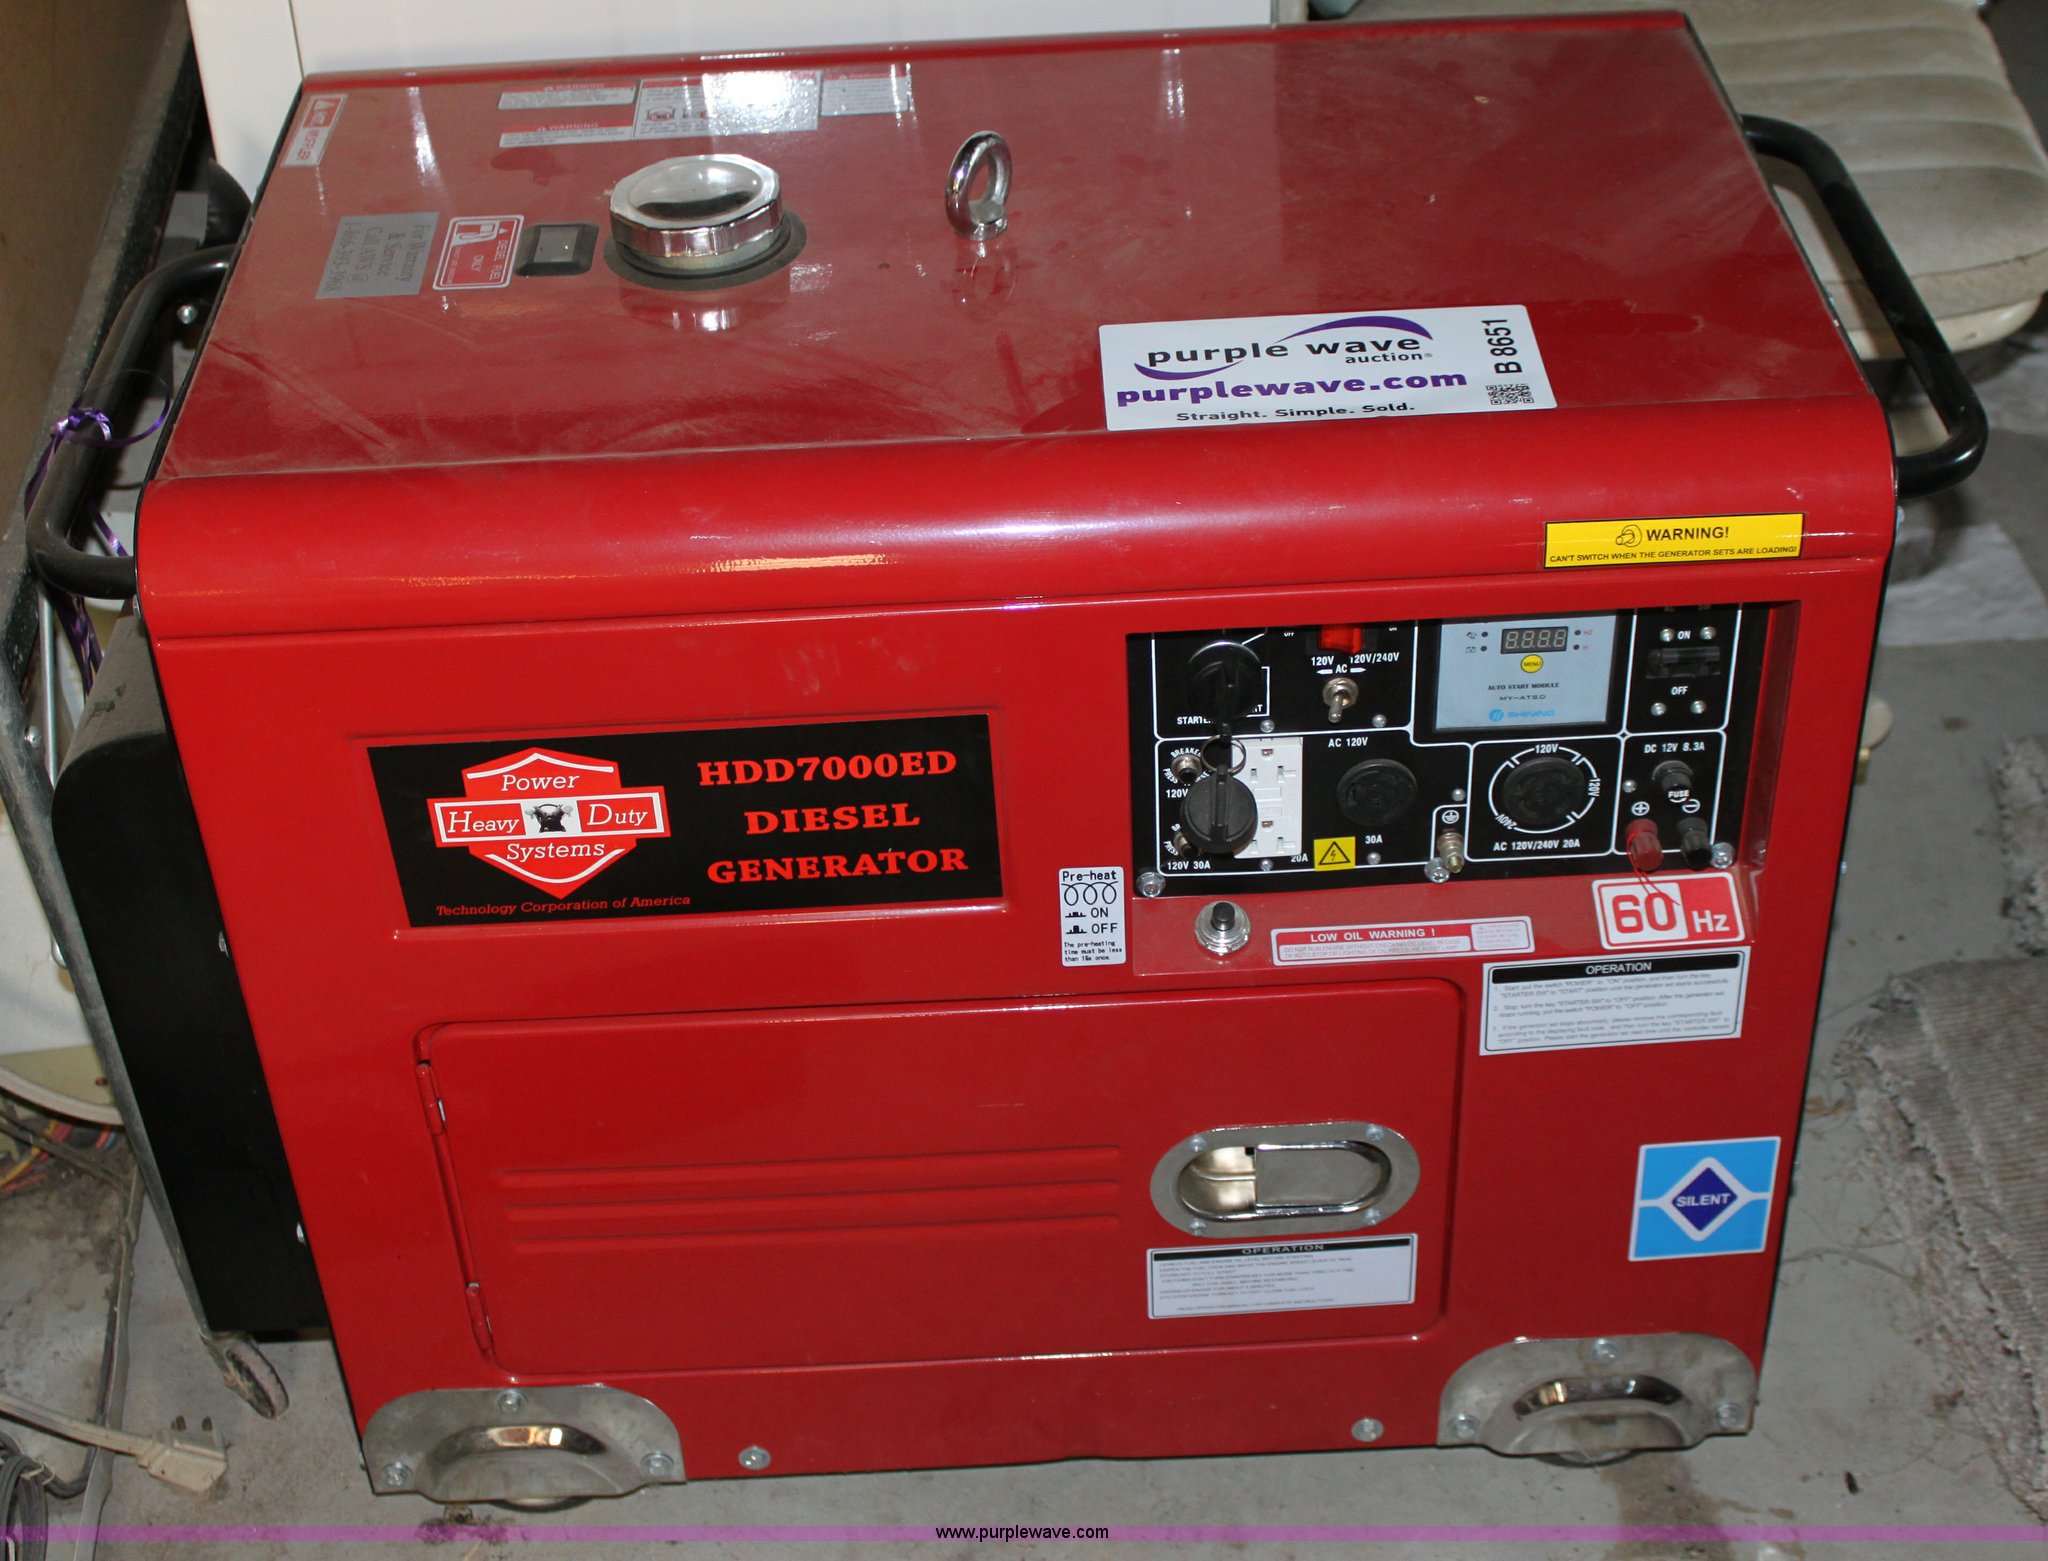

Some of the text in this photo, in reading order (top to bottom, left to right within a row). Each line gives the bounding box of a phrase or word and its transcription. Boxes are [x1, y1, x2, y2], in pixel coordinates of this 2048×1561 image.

[1148, 338, 1420, 367] purple wave
[1481, 319, 1523, 375] B 8651
[1117, 372, 1467, 407] purplewave.com
[1176, 402, 1414, 422] Straight. Simple. Sold.
[1646, 526, 1729, 542] WARNING!
[1550, 546, 1797, 563] CAN'T SWITCH WHEN THE GENERATOR SETS ARE LOADING!
[1677, 630, 1691, 640] ON
[1311, 652, 1400, 666] 120V 120V/240V
[1335, 664, 1348, 674] AC
[1671, 686, 1688, 696] OFF
[1177, 716, 1213, 724] START
[1328, 737, 1368, 748] AC 120V
[1535, 744, 1559, 753] 120V
[1644, 742, 1705, 753] DC 12V 8.3A
[697, 750, 957, 786] HDD7000ED
[501, 774, 580, 792] Power
[1588, 778, 1600, 797] 120V
[1166, 788, 1189, 798] 120V
[1668, 790, 1690, 798] FUSE
[448, 804, 648, 834] Heavy Duty
[744, 803, 920, 835] DIESEL
[1495, 813, 1517, 830] 240V
[1365, 835, 1383, 844] 30A
[1493, 839, 1580, 851] AC 120V/240V 20A
[507, 842, 605, 862] Systems
[1291, 854, 1308, 863] 20A
[707, 849, 968, 883] GENERATOR
[1167, 860, 1211, 871] 120V 30A
[1062, 870, 1117, 881] Pre-heat
[436, 896, 690, 916] Technology Corporation of America
[1090, 907, 1109, 918] ON
[1612, 892, 1730, 934] 60 Hz
[1091, 923, 1118, 934] OFF
[1311, 933, 1337, 942] LOW
[1344, 931, 1363, 940] OIL
[1369, 929, 1426, 939] WARNING
[1585, 962, 1652, 975] OPERATION
[1676, 1193, 1732, 1207] SILENT
[1241, 1244, 1325, 1256] OPERATION
